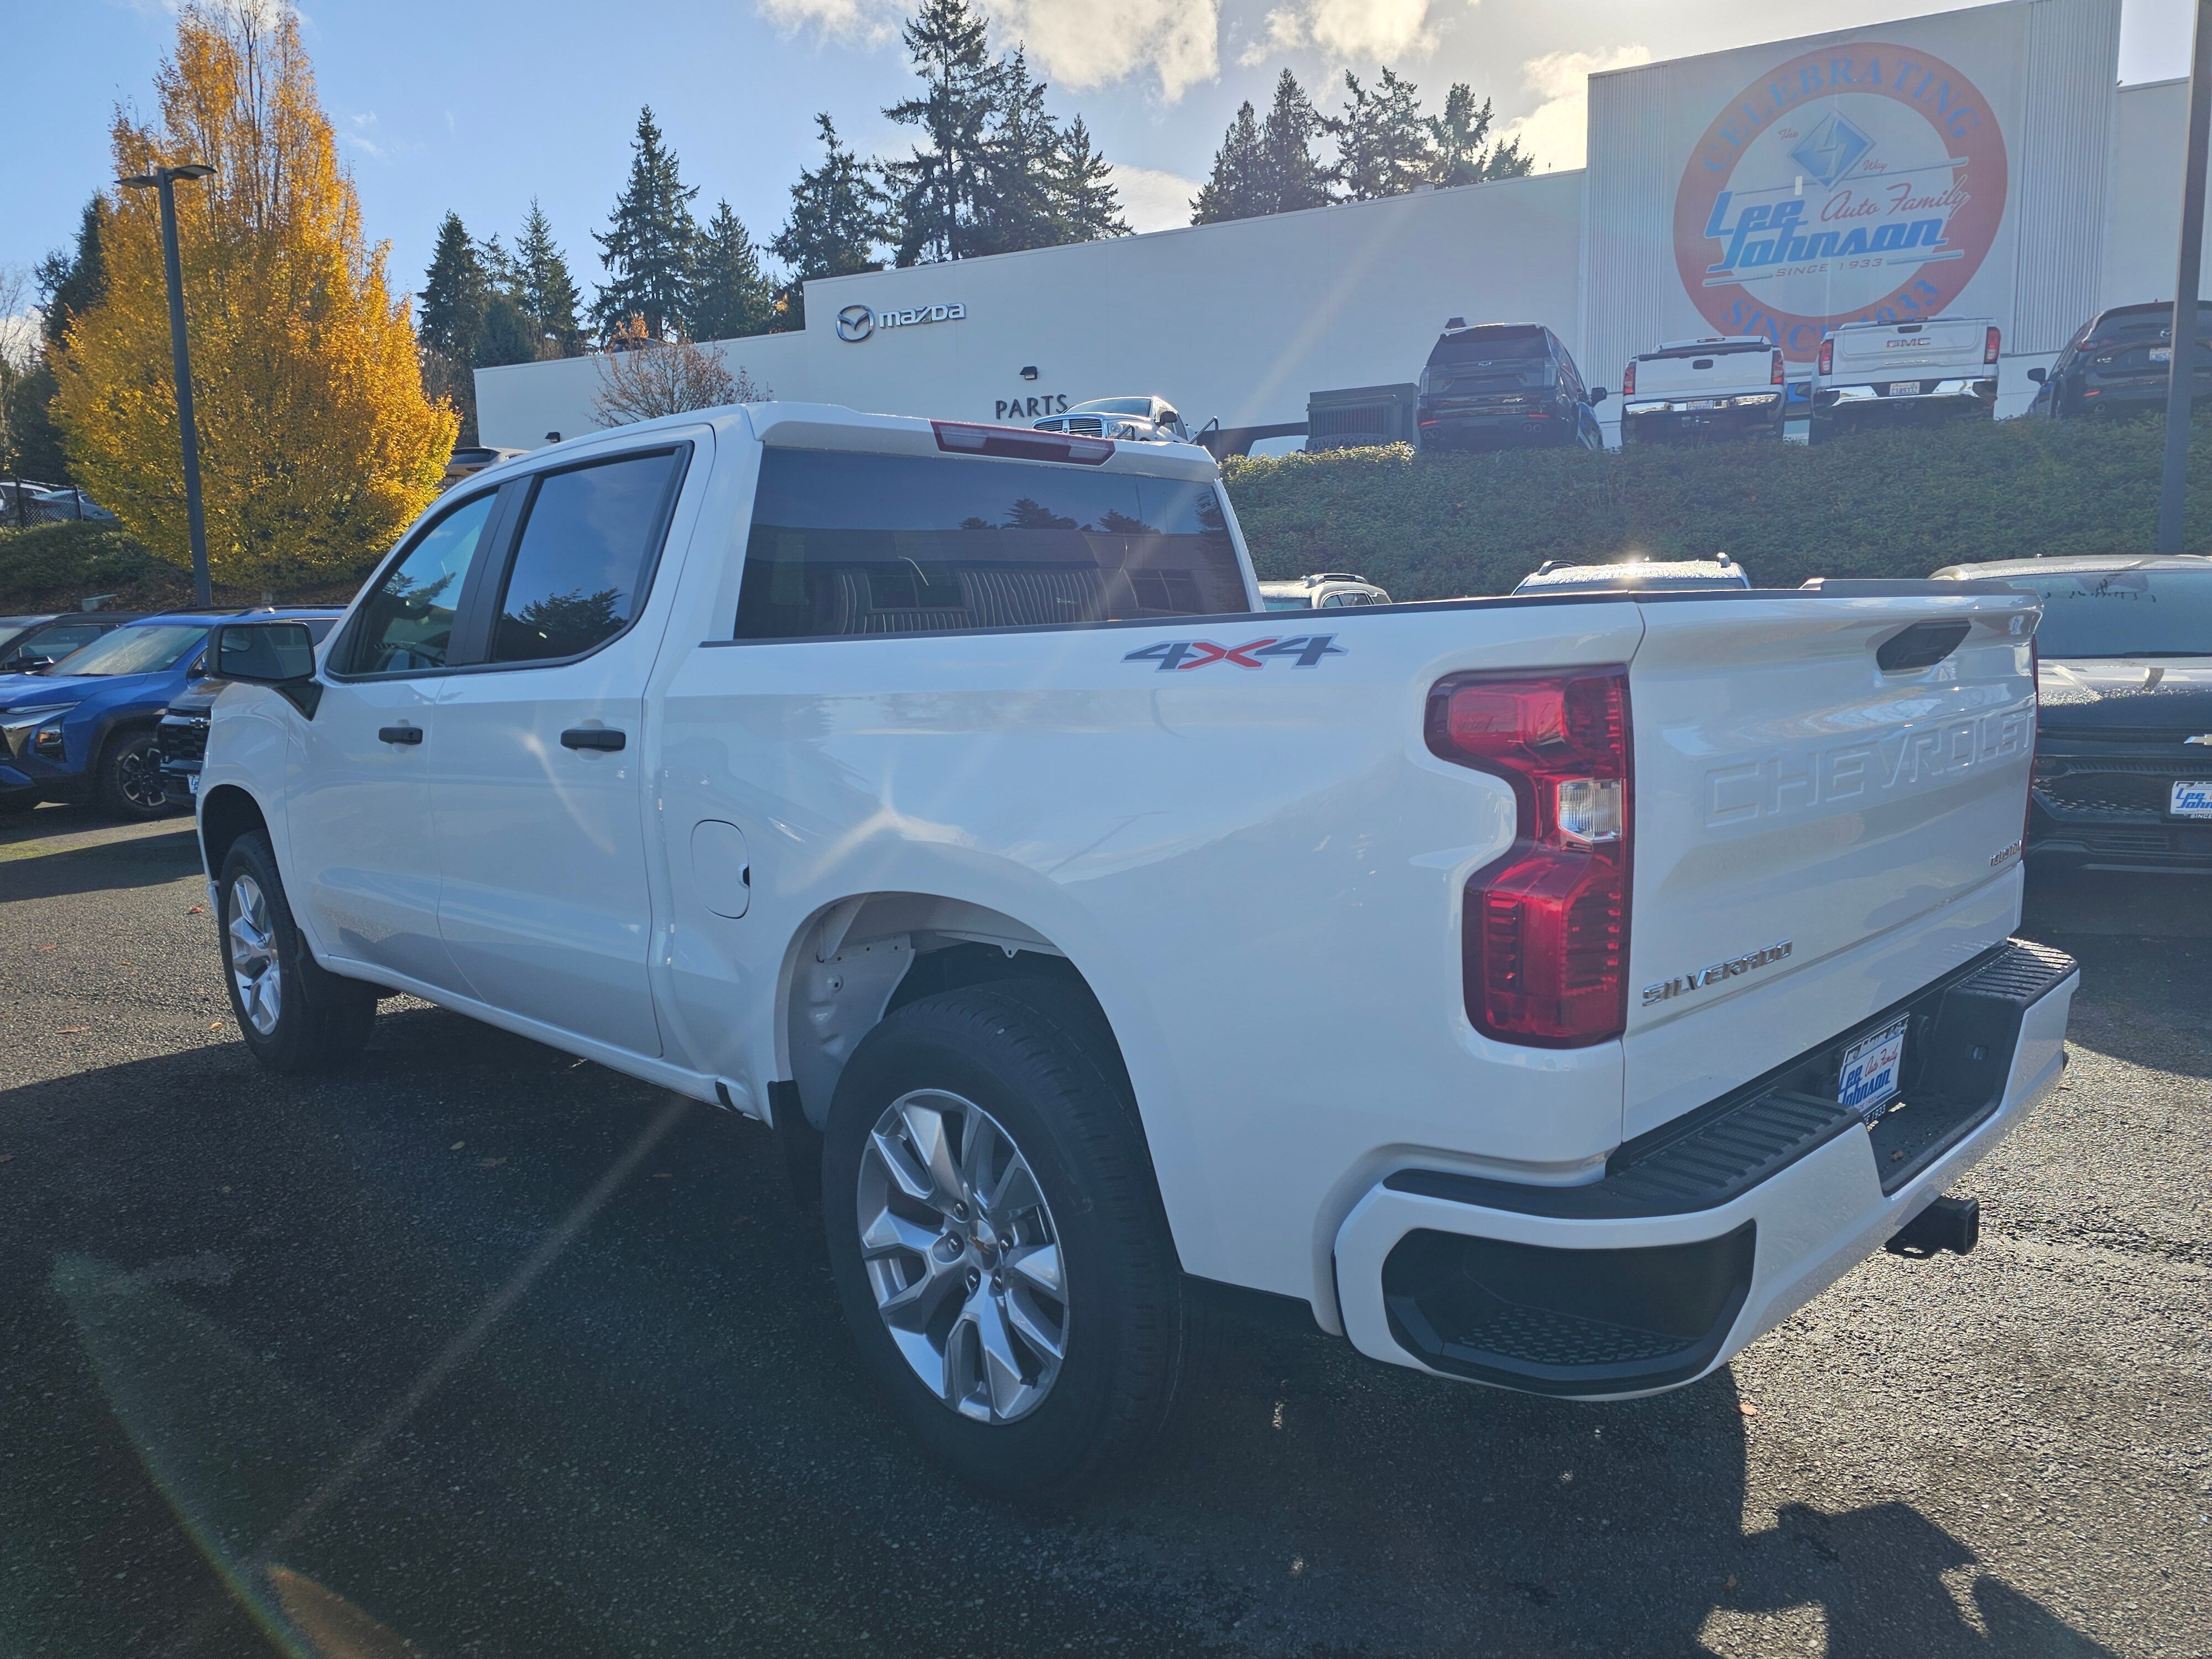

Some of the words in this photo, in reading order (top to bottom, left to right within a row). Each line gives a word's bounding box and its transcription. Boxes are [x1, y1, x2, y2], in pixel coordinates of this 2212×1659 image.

[1703, 56, 1980, 170] CELEBRATING
[1778, 128, 1799, 140] The
[1863, 160, 1887, 172] Way
[1704, 191, 1807, 238] Lee
[1820, 190, 1880, 222] Auto
[1886, 175, 1969, 220] Family
[1707, 217, 1948, 272] Johnson
[1776, 263, 1829, 276] SINCE
[1839, 258, 1883, 271] 1933
[879, 302, 966, 328] mazda
[1860, 279, 1938, 325] 933
[1886, 337, 1931, 347] GMC
[995, 394, 1068, 420] PARTS
[1704, 706, 2034, 829] CHEVROLET
[2176, 788, 2205, 800] Lee
[1642, 938, 1792, 1006] SILVERADO
[1839, 1063, 1863, 1094] Lee
[1843, 1068, 1891, 1106] Johnson
[1872, 1104, 1886, 1120] 1933
